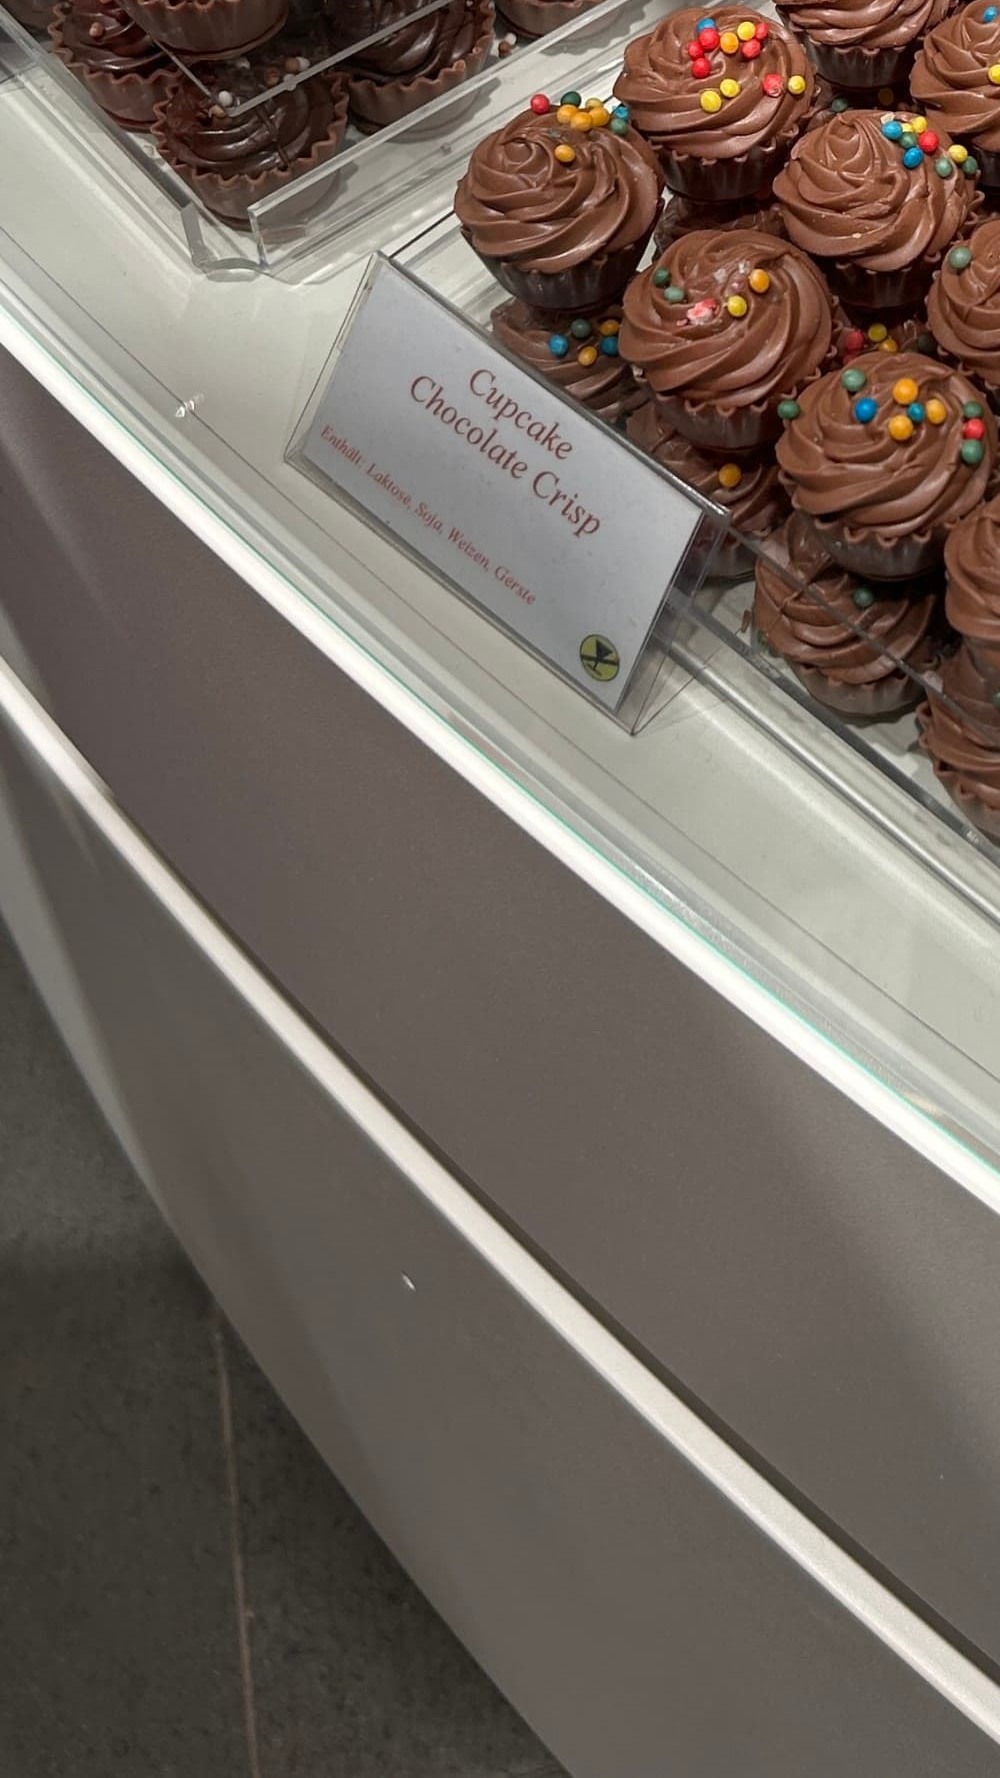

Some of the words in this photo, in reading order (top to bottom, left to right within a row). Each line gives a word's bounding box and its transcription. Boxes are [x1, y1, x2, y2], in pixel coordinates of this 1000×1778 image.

[409, 374, 529, 480] Chocolate
[531, 470, 602, 537] Crisp
[468, 367, 574, 462] Cupcake
[366, 462, 413, 511] Laktose,
[414, 501, 444, 535] Soja,
[448, 526, 491, 572] Weizen,
[494, 564, 537, 607] Gerste
